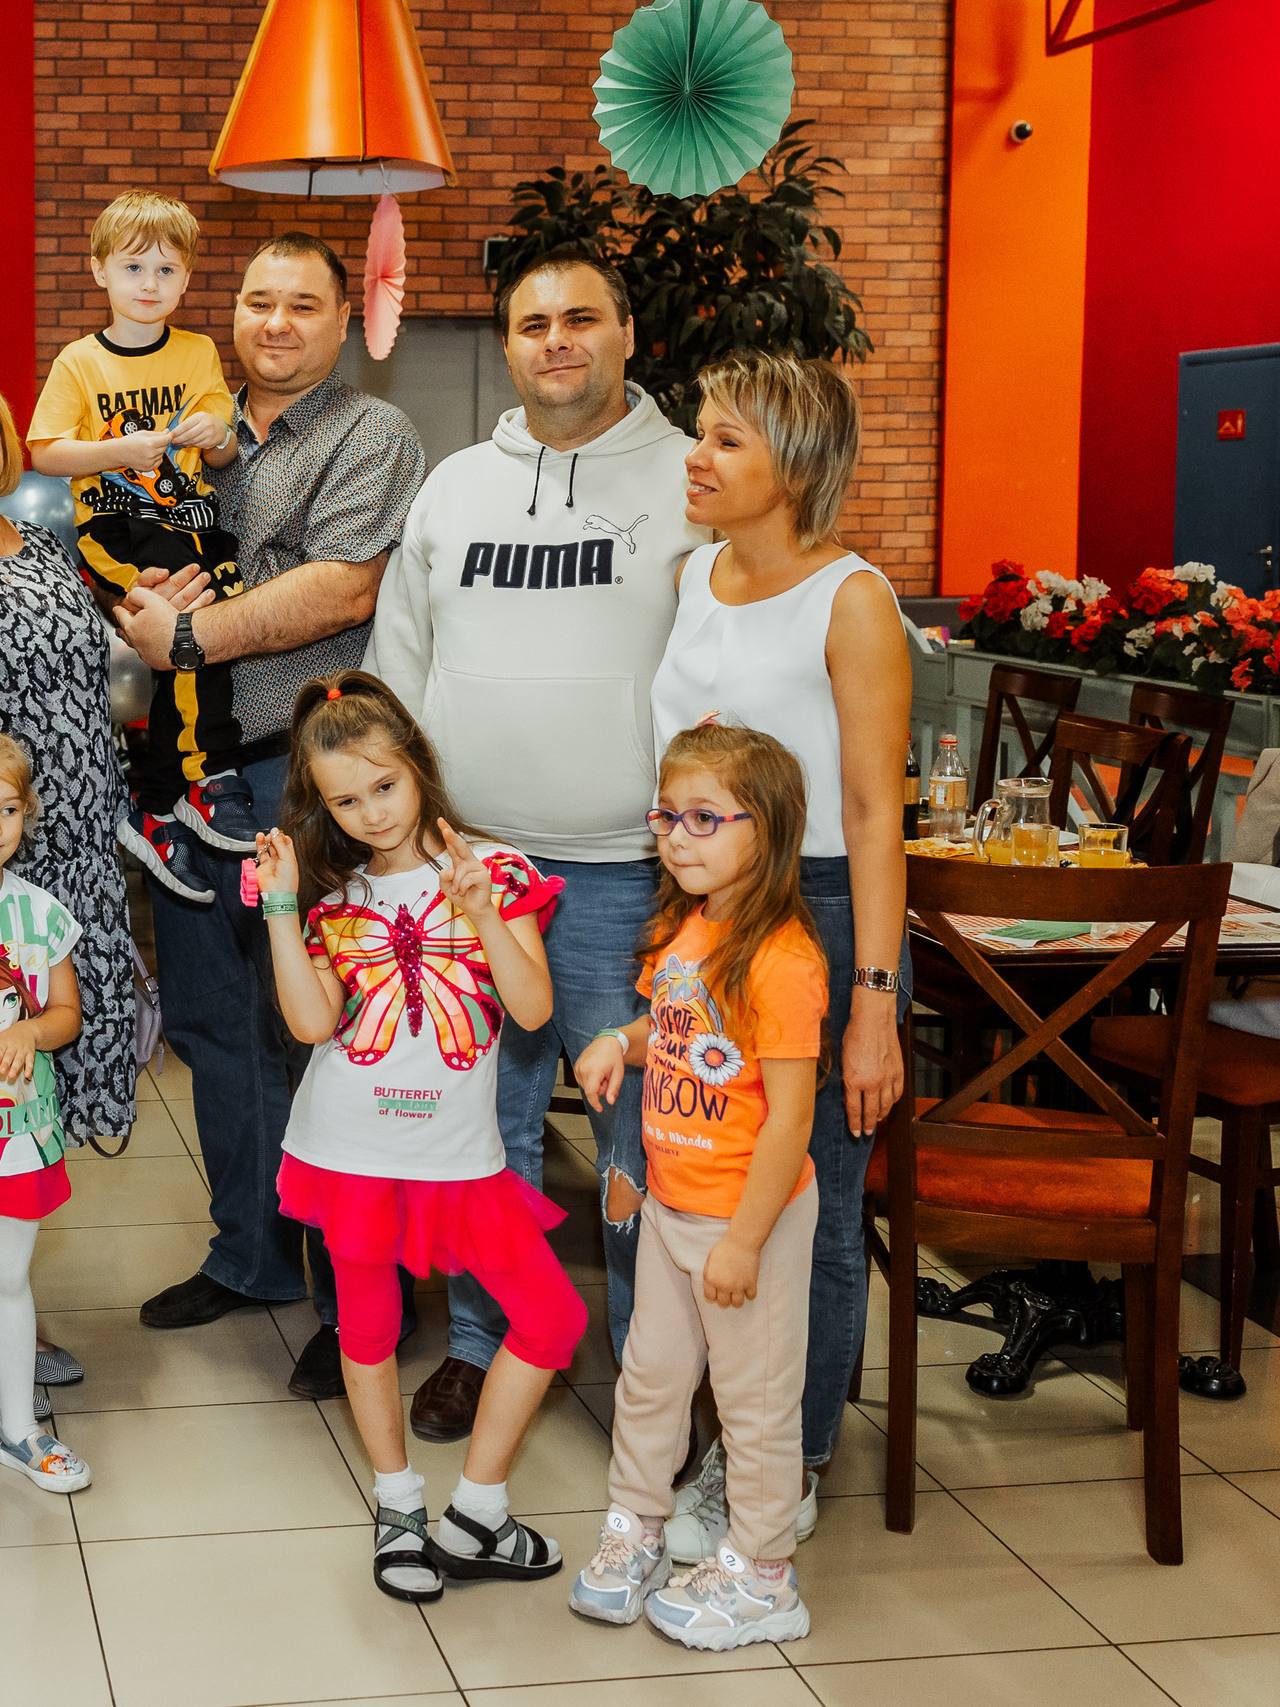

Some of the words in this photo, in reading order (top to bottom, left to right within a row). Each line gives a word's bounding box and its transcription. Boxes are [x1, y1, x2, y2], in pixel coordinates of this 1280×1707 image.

[97, 383, 186, 422] BATMAN
[460, 539, 614, 589] PUMA
[374, 1086, 442, 1100] BUTTERFLY
[379, 1108, 389, 1116] of
[395, 1108, 433, 1119] flowers
